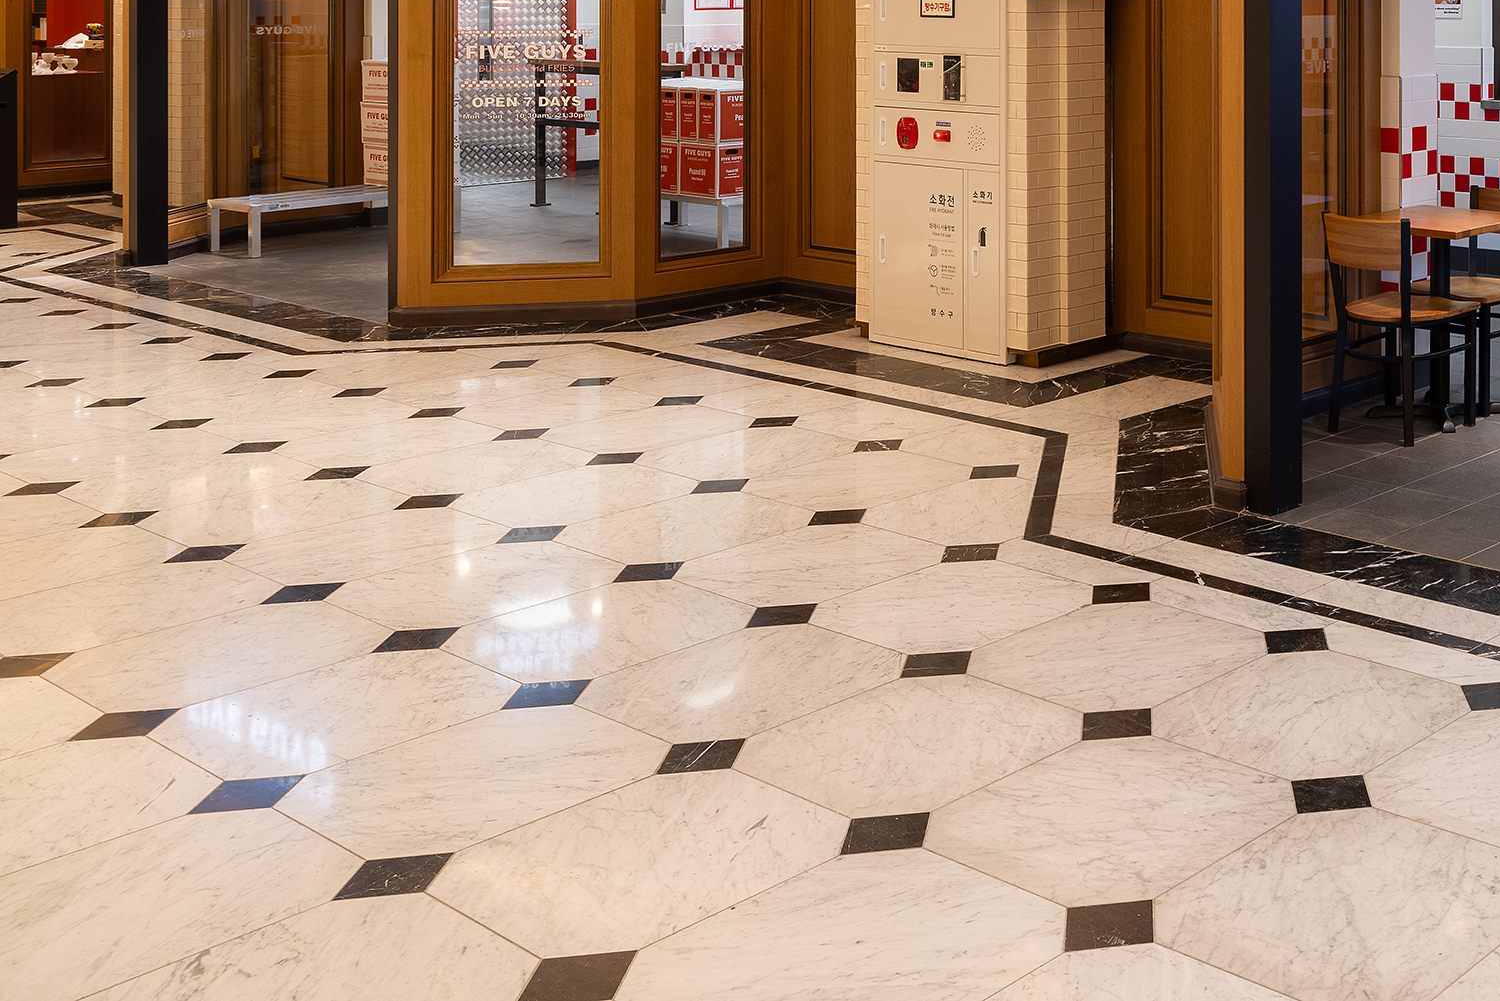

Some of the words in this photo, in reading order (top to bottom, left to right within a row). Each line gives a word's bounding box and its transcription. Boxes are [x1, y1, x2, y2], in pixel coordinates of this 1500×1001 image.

[465, 45, 516, 60] FIVE
[523, 44, 587, 59] GUYS
[478, 64, 525, 73] BURGERS
[528, 64, 545, 73] and
[547, 63, 576, 72] FRIES
[368, 70, 382, 78] FIVE
[471, 97, 518, 108] OPEN
[523, 96, 533, 107] 7
[538, 95, 582, 107] DAYS
[367, 112, 380, 120] FIVE
[370, 153, 382, 162] FIVE
[685, 148, 696, 156] FIVE
[697, 149, 711, 157] GUYS
[972, 190, 993, 200] 소화기
[929, 194, 955, 208] 소화전
